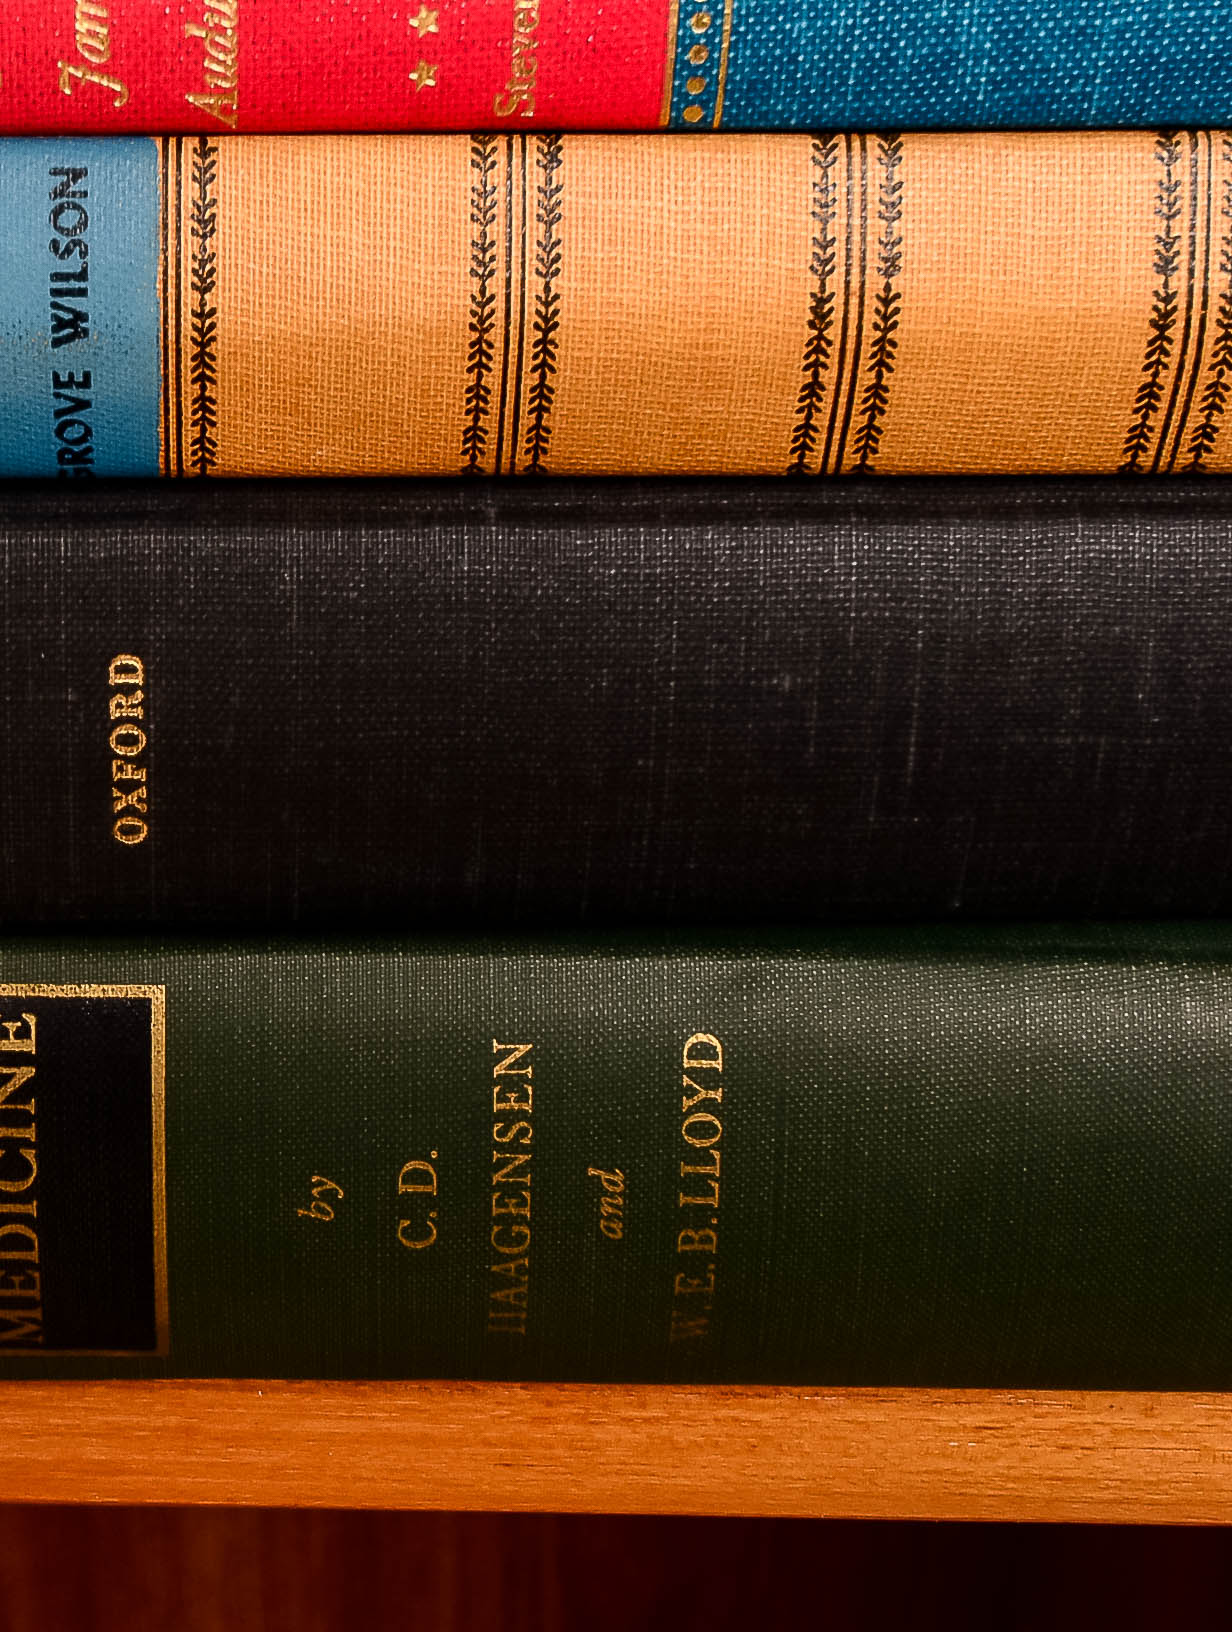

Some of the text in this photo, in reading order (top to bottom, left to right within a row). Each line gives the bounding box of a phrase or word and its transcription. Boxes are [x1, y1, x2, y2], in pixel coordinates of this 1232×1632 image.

[48, 166, 90, 350] WILSON
[108, 653, 149, 846] OXFORD
[297, 1175, 345, 1222] by
[487, 1038, 534, 1336] HAAGENSEN
[587, 1167, 626, 1240] and
